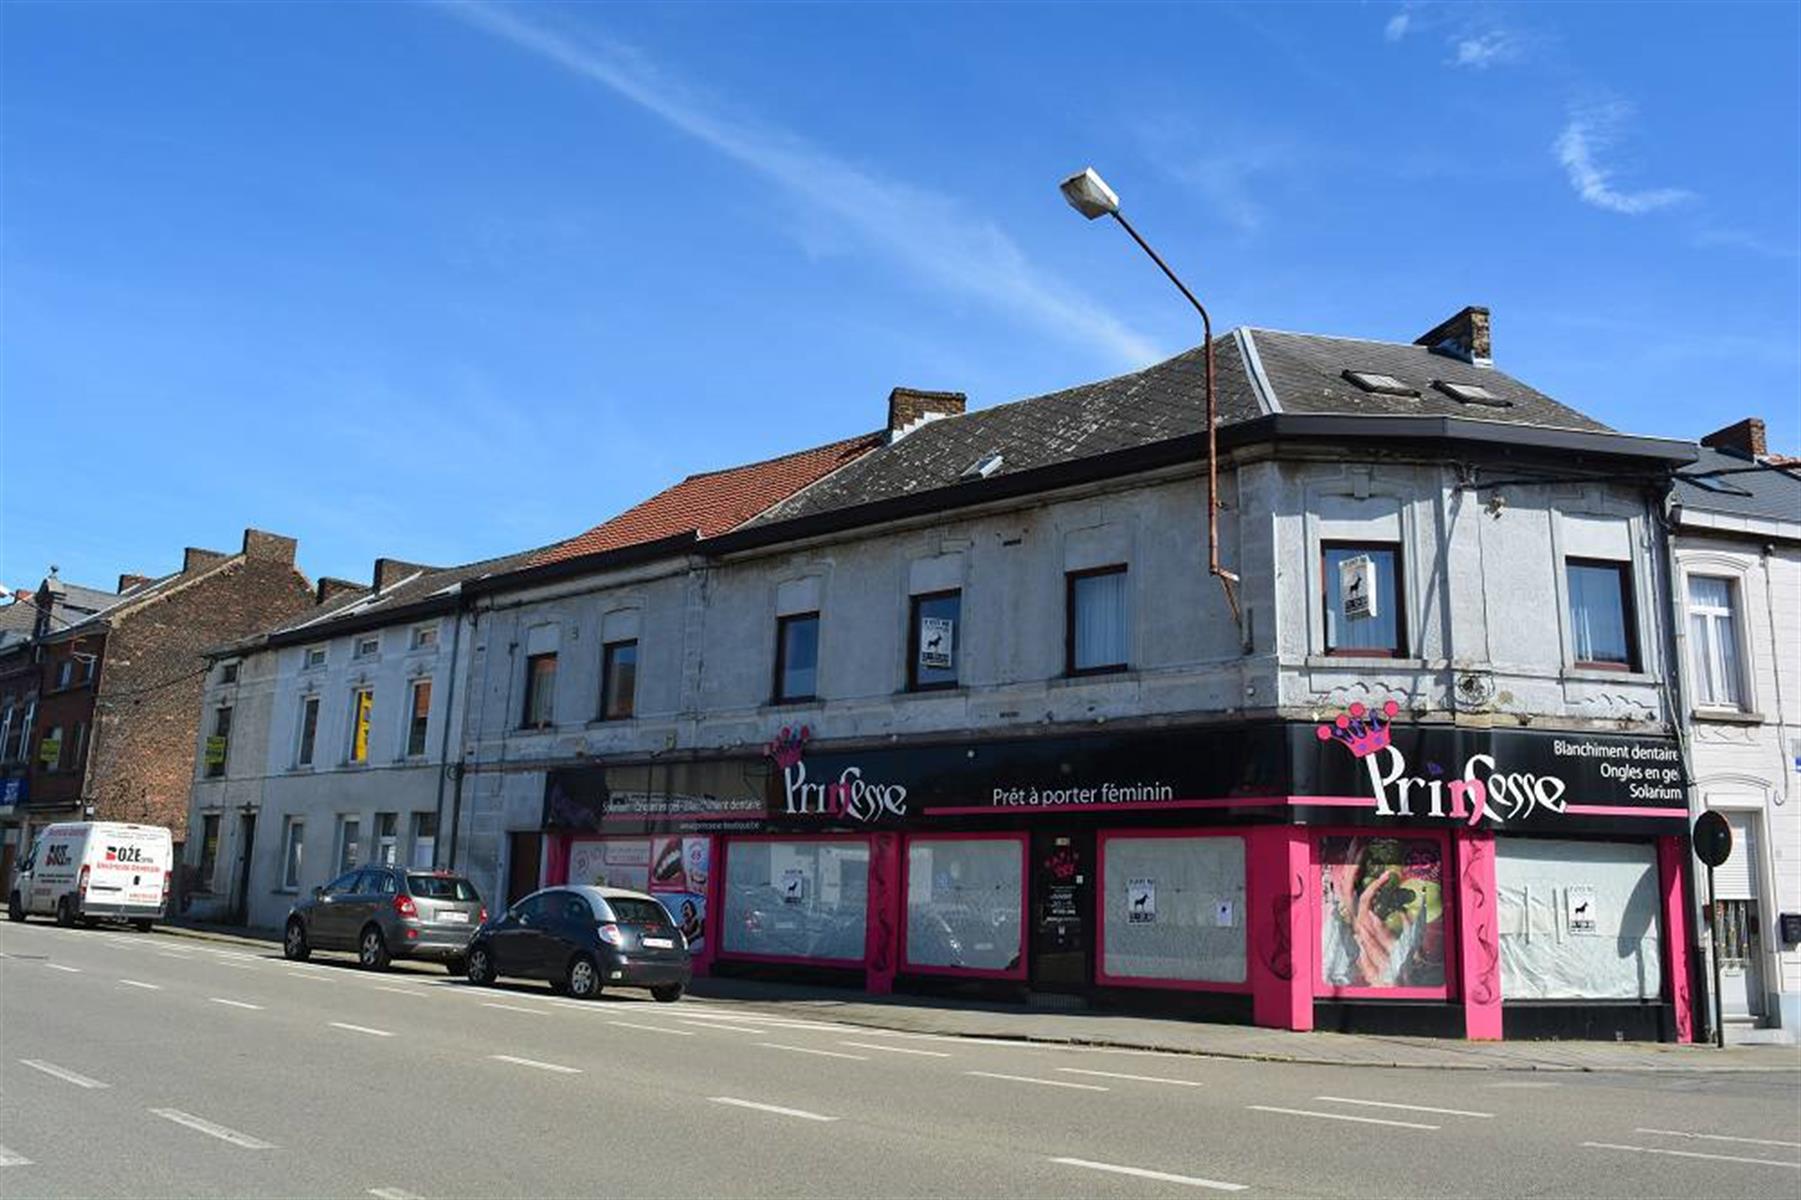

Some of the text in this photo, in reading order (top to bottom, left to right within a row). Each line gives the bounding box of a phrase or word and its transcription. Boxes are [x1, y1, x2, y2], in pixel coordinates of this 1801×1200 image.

[1553, 740, 1679, 761] Blanchiment dentaire
[1600, 762, 1642, 782] Ongles
[1645, 768, 1660, 780] en
[993, 781, 1173, 807] Prêt à porter féminin
[1629, 782, 1683, 800] Solarium
